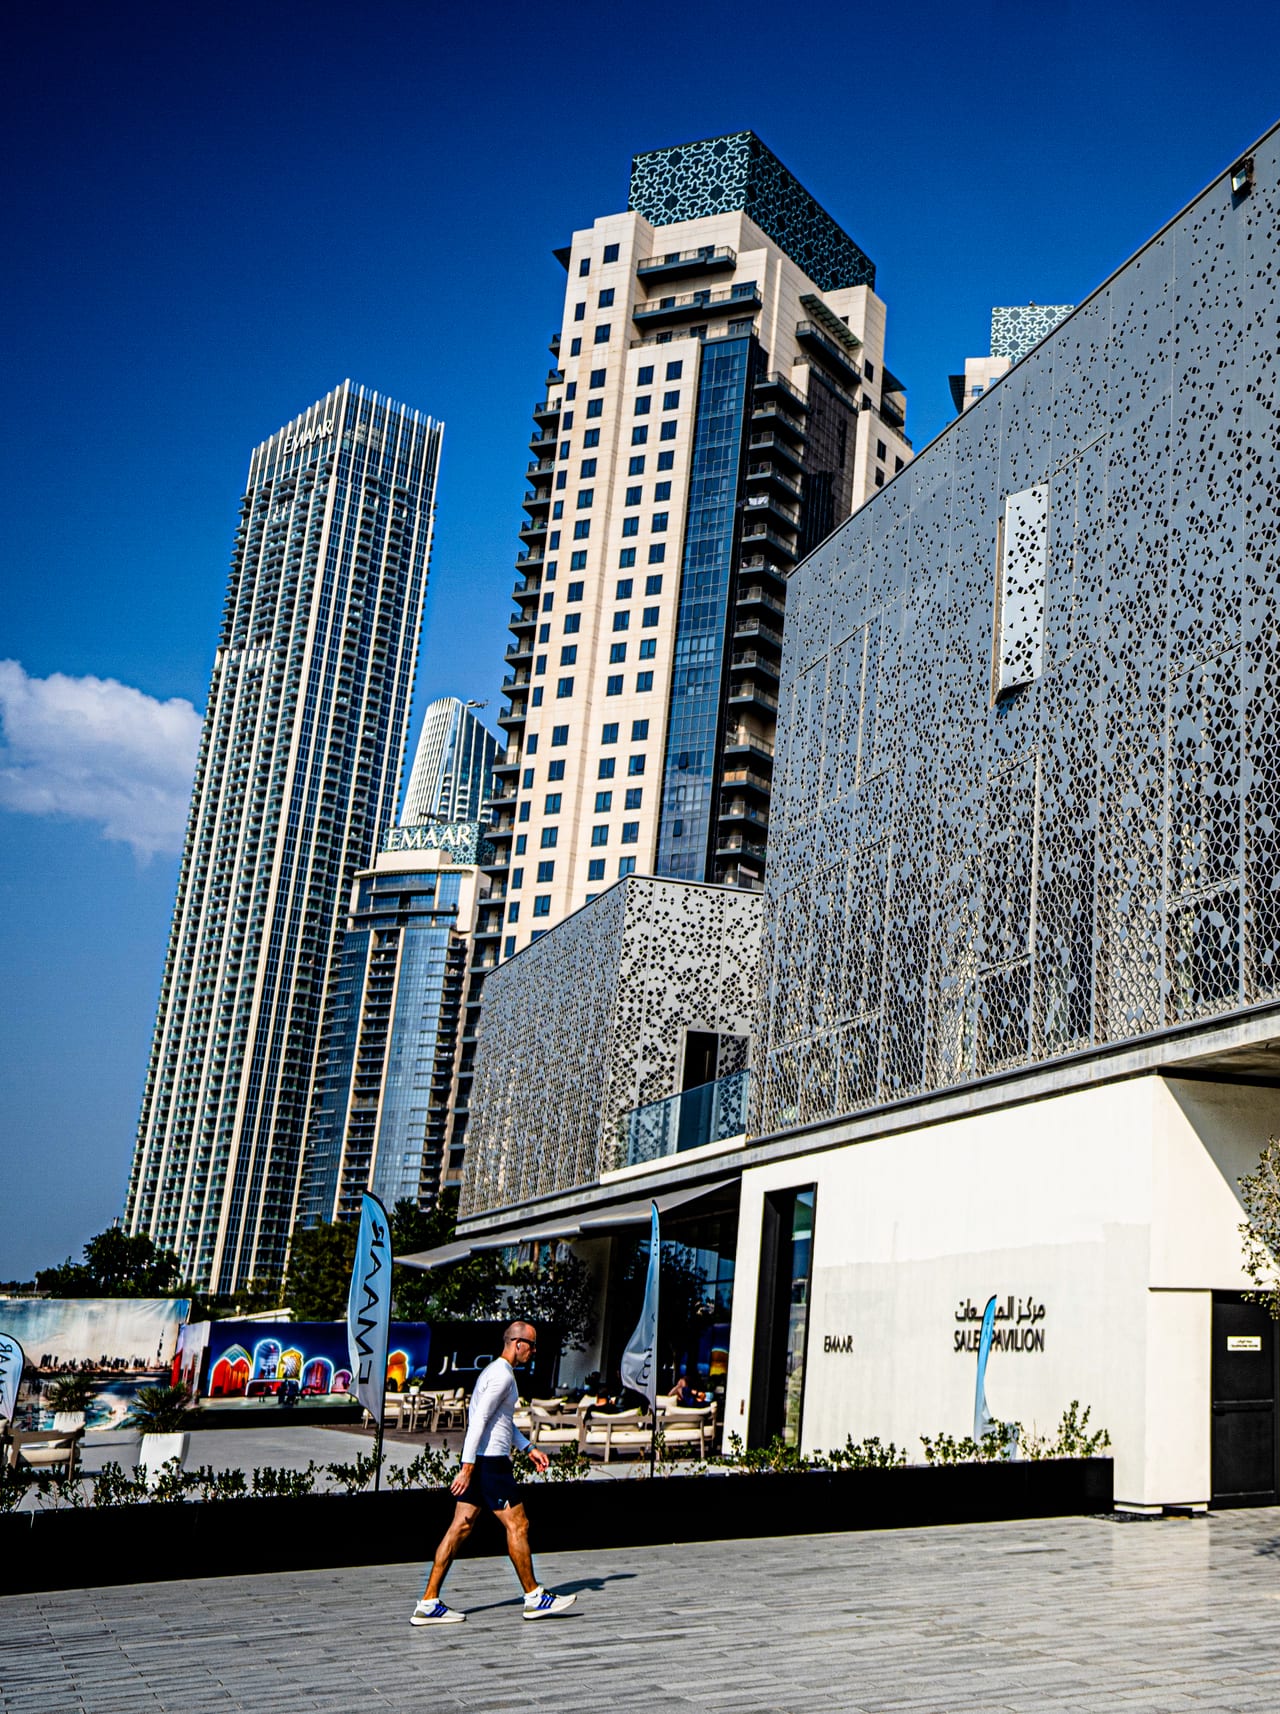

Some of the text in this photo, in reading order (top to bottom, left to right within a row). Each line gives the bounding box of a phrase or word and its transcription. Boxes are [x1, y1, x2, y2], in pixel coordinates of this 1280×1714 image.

[283, 419, 334, 455] EMAAR
[387, 825, 471, 849] EMAAR
[954, 1295, 1046, 1326] مركز المعات
[823, 1335, 854, 1353] EMAAR
[953, 1329, 981, 1353] SALE
